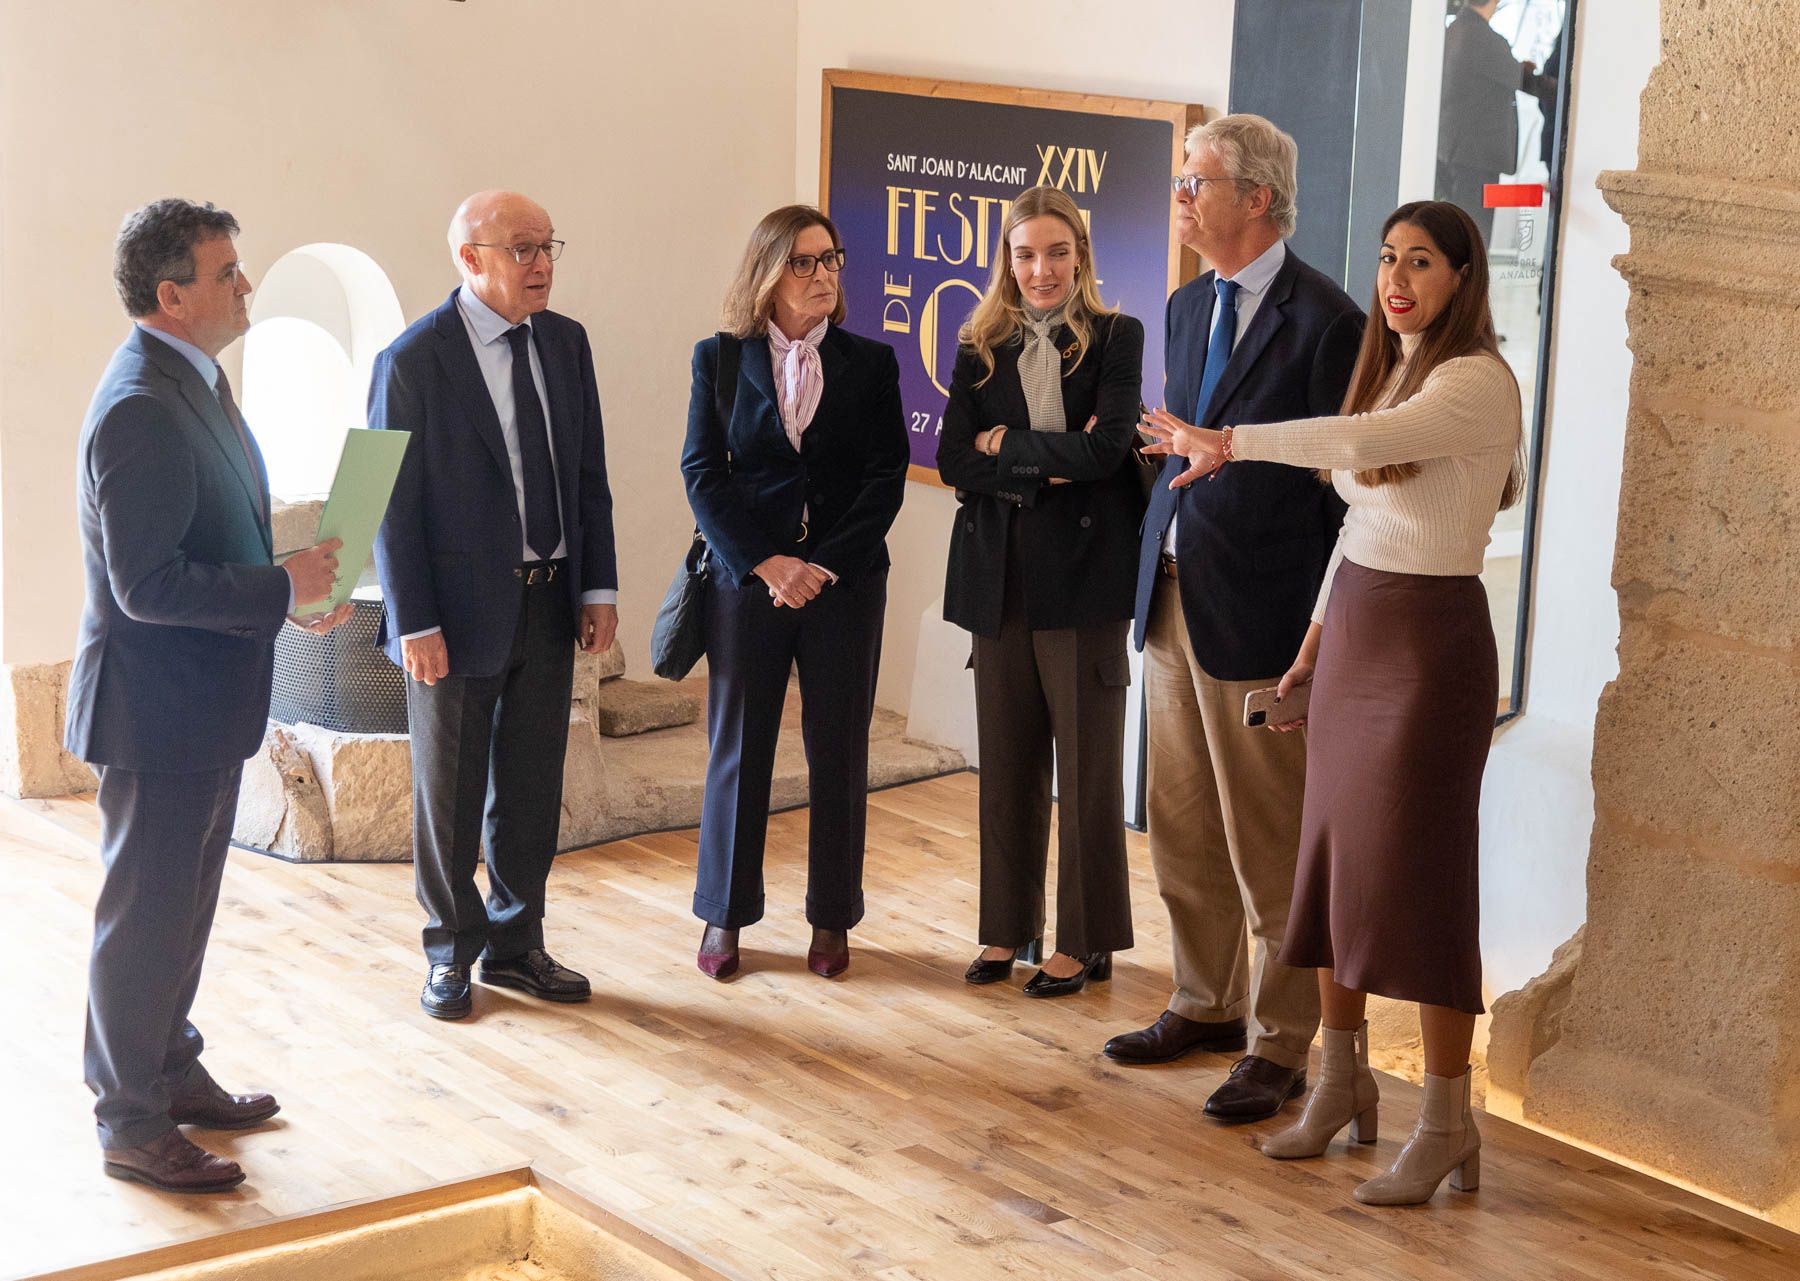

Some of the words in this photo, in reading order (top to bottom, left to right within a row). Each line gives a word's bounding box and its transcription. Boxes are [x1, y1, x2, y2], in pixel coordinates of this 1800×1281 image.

[887, 153, 917, 173] SANT
[920, 157, 953, 177] JOAN
[1036, 144, 1107, 194] XXIV
[883, 271, 912, 334] DE
[911, 411, 930, 433] 27
